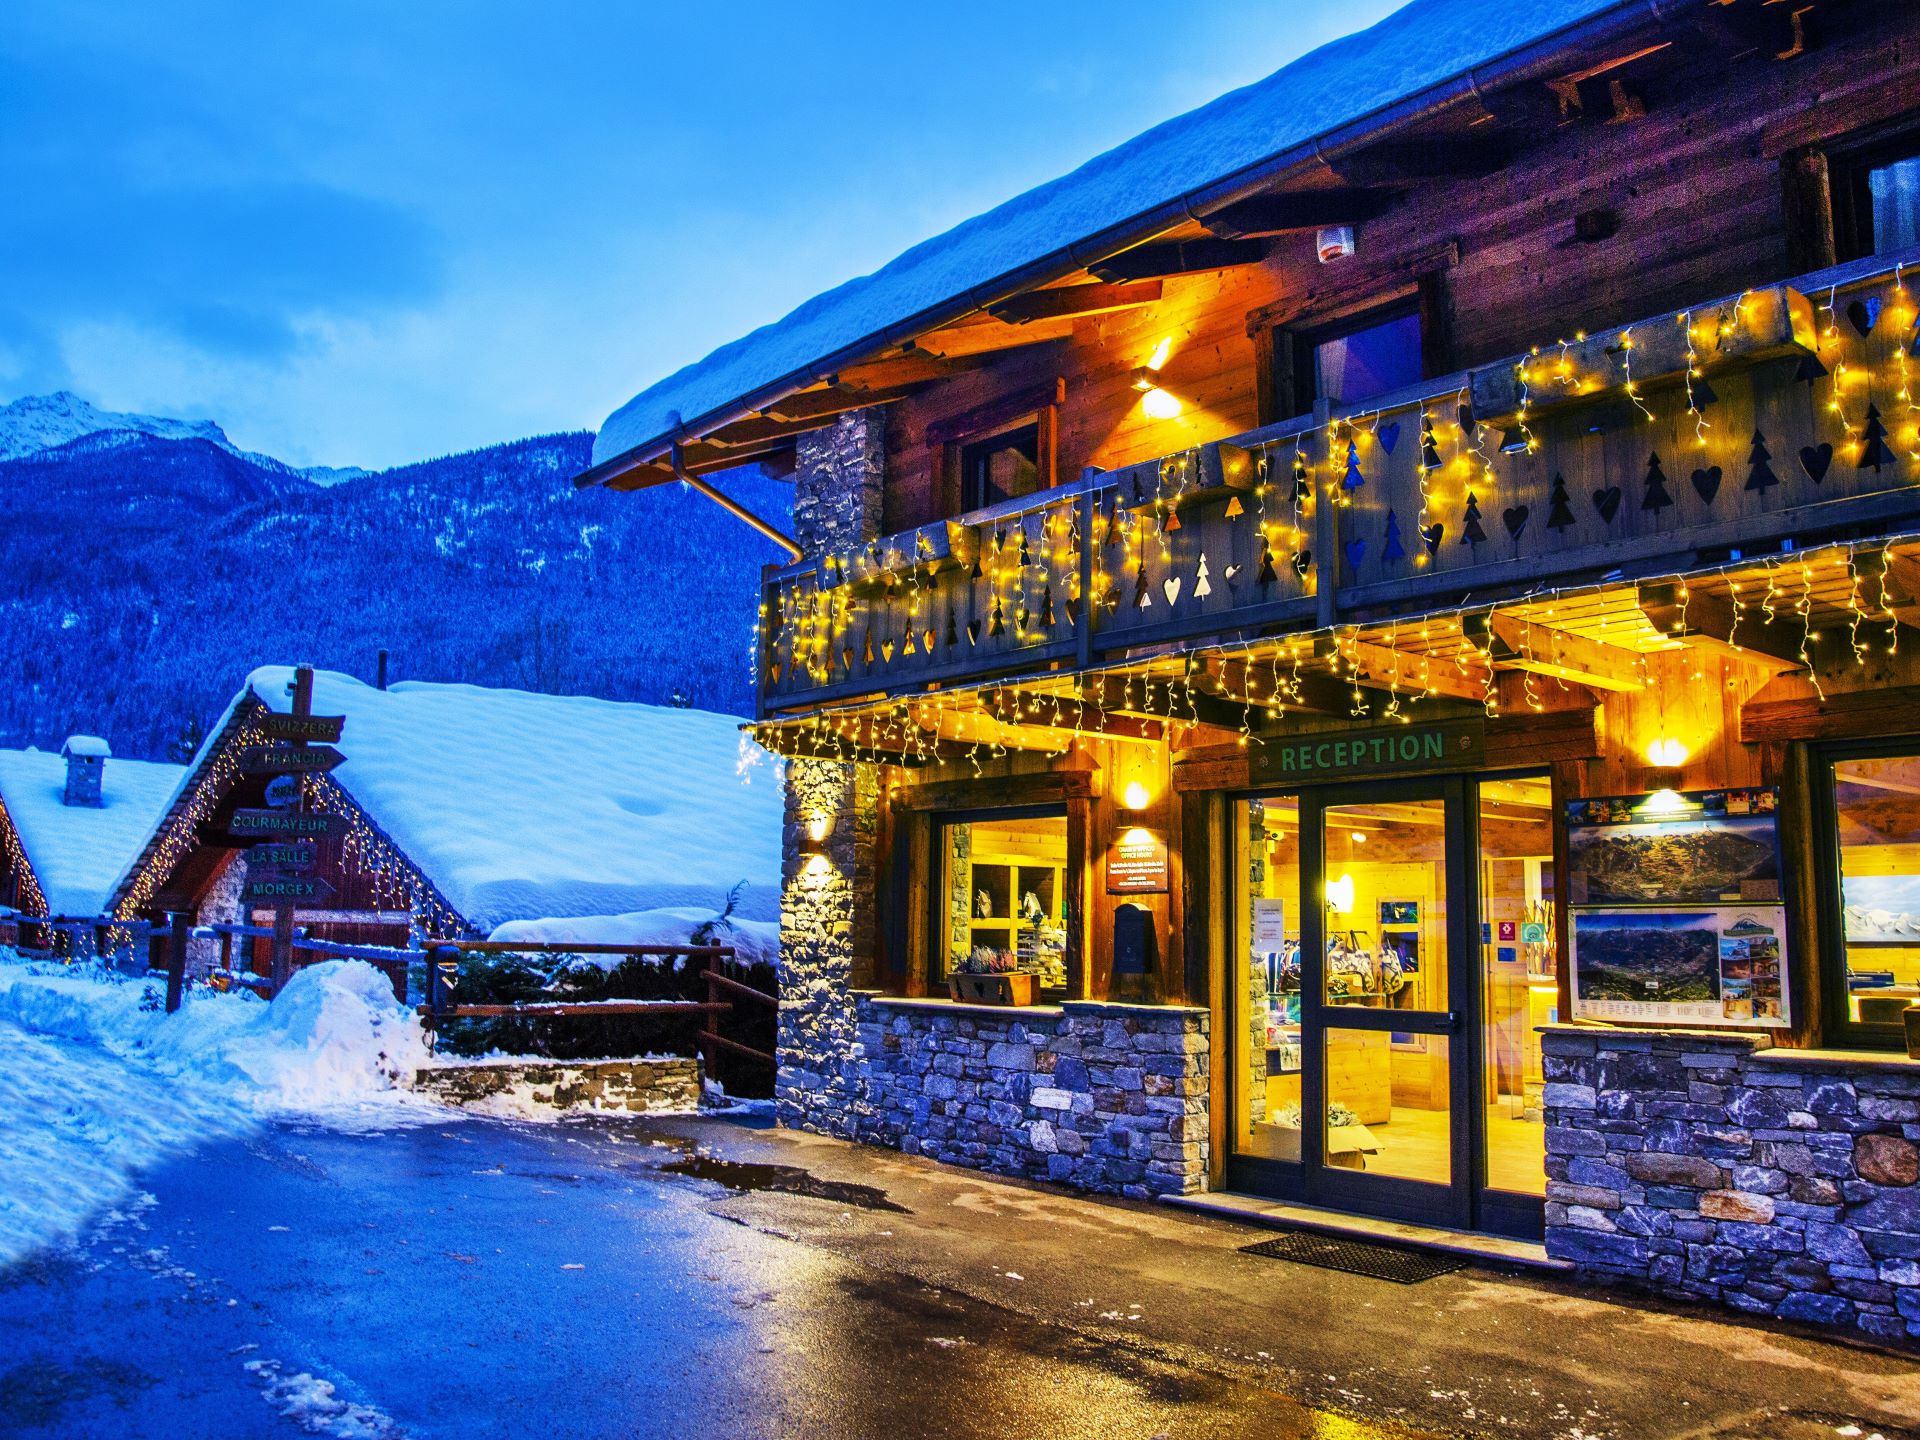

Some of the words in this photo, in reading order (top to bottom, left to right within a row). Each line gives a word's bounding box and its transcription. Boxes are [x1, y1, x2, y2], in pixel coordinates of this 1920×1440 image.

[269, 719, 336, 735] SVIZZERA
[264, 753, 325, 764] FRANCIA
[1281, 732, 1444, 771] RECEPTION
[231, 815, 328, 832] COURMAYEUR
[251, 851, 267, 862] LA
[271, 850, 309, 862] SALLE
[253, 882, 314, 895] MORGEX
